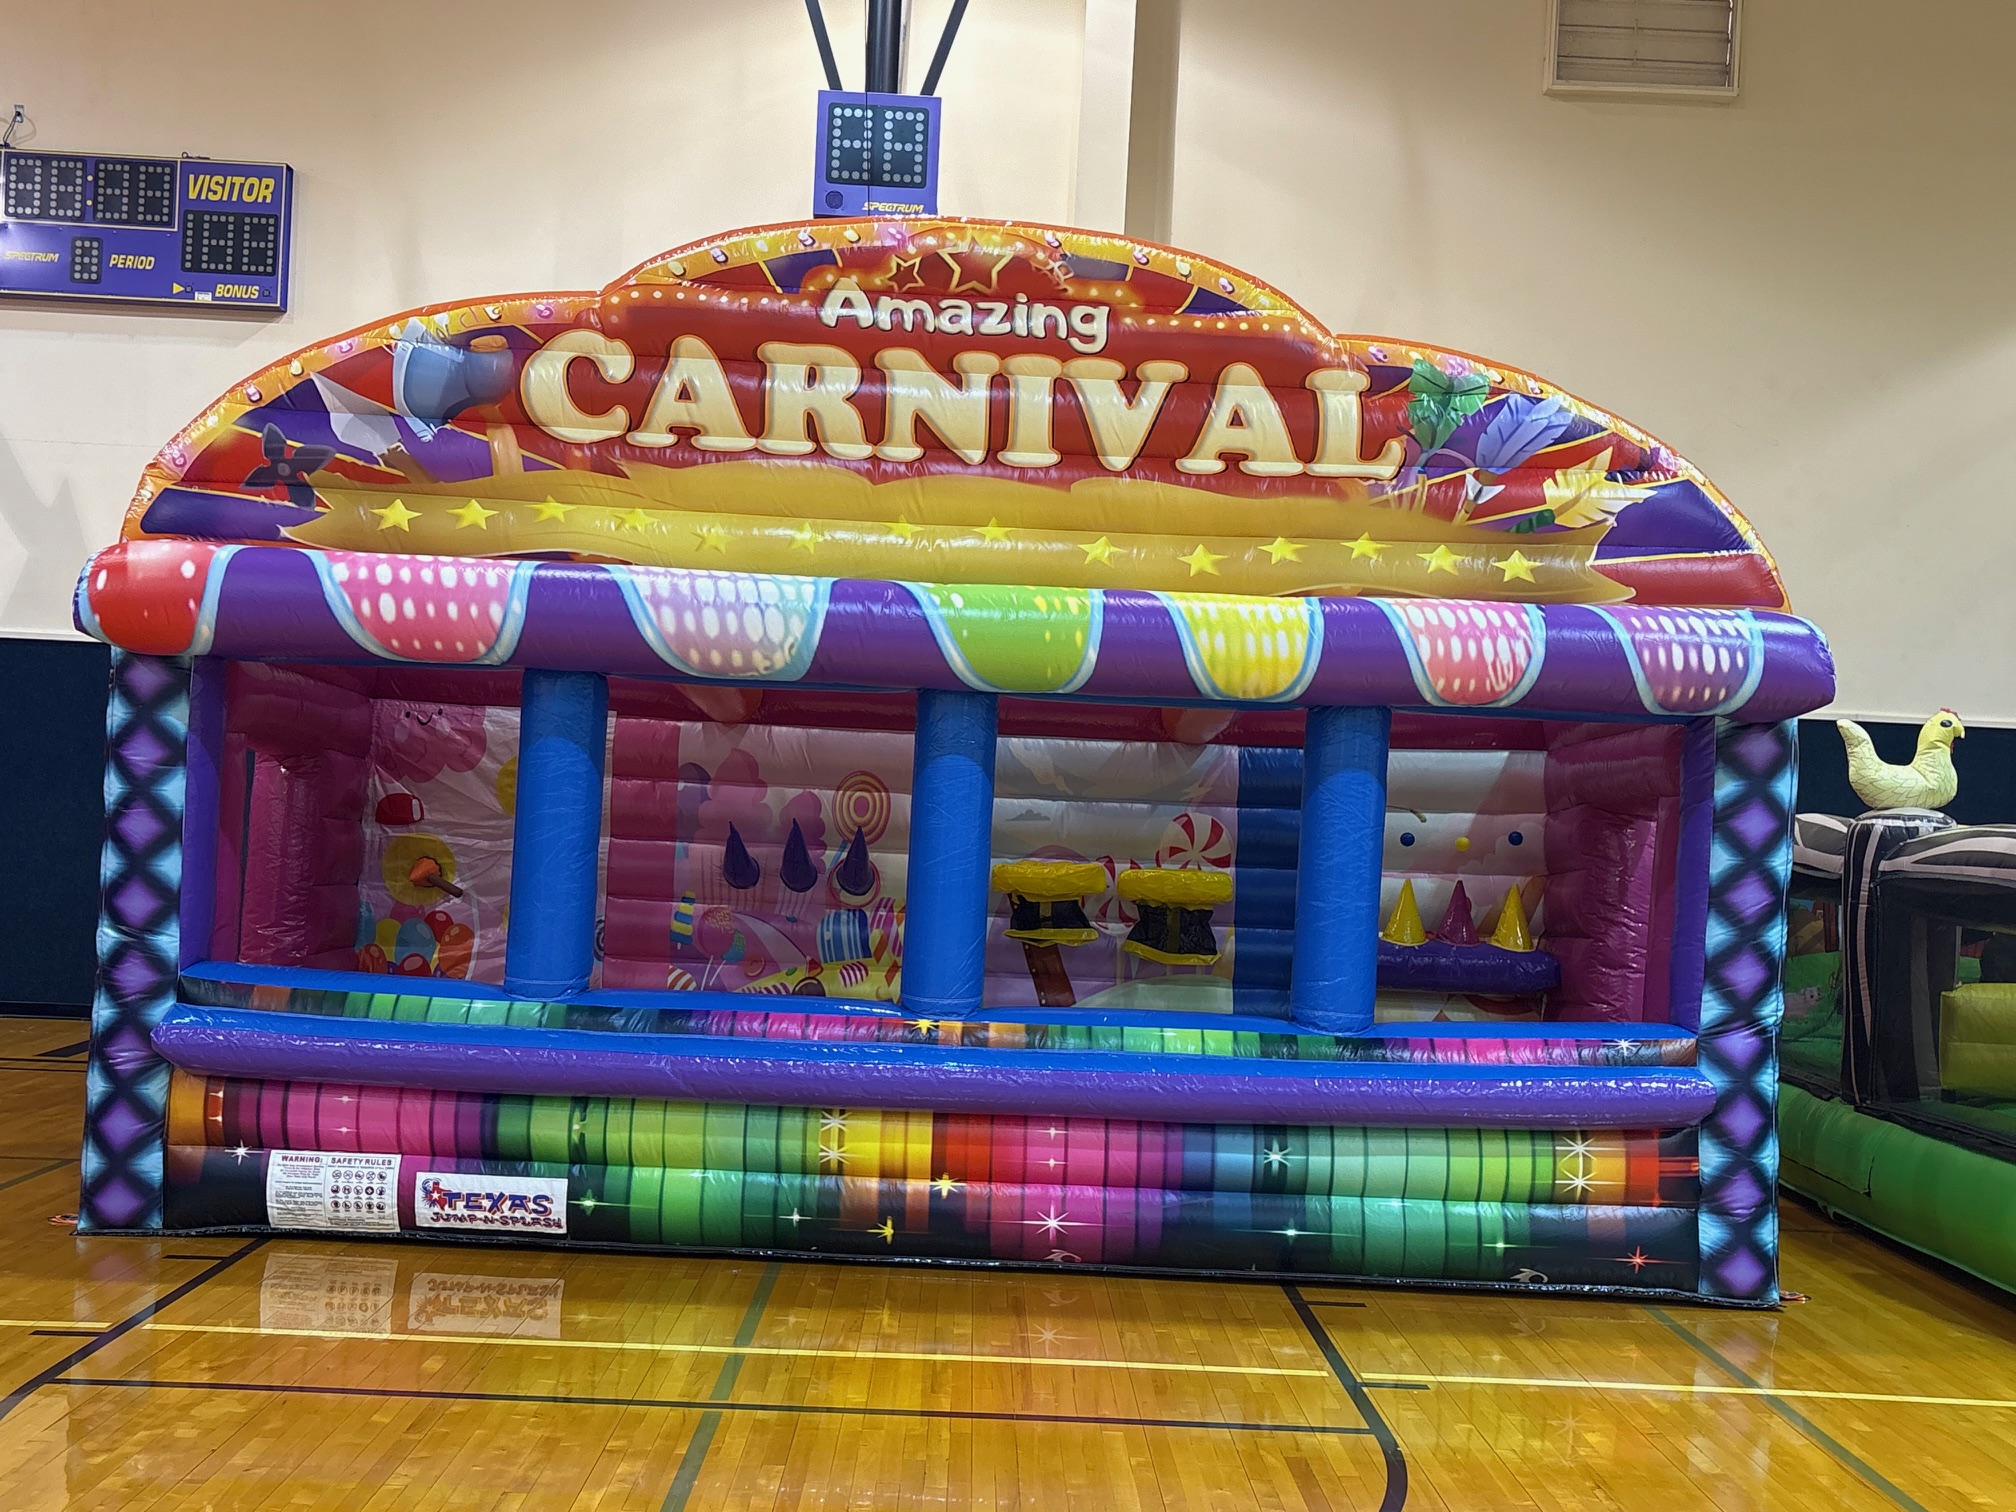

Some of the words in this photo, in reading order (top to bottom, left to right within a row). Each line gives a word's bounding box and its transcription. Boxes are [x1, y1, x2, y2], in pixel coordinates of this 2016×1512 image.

[189, 174, 275, 203] VISITOR
[862, 201, 924, 213] SPECTRUM
[4, 251, 60, 263] SPECTRUM
[109, 254, 155, 270] PERIOD
[215, 284, 260, 299] BONUS
[820, 280, 1110, 354] Amazing
[521, 330, 1404, 479] CARNIVAL
[331, 1157, 363, 1166] SAFETY
[364, 1158, 392, 1166] RULES
[442, 1191, 554, 1217] TEXAS
